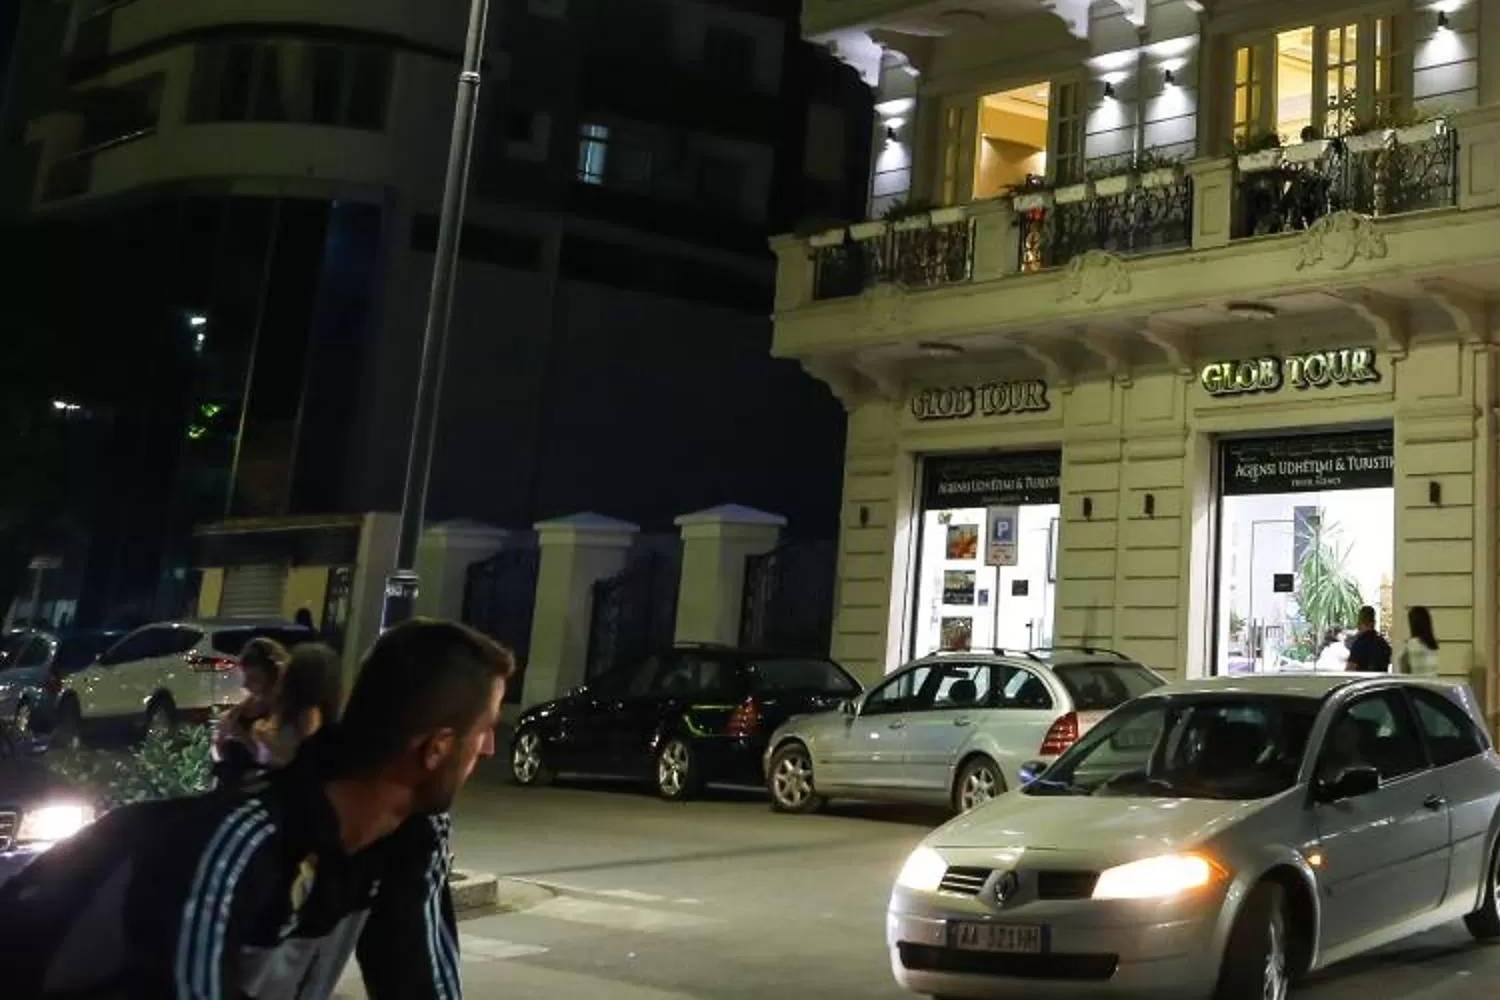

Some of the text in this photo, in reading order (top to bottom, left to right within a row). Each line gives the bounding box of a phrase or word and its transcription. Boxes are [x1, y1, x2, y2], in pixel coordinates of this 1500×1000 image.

[1202, 348, 1381, 394] GLOB TOUR
[976, 379, 1051, 416] TOUR
[997, 521, 1009, 537] P
